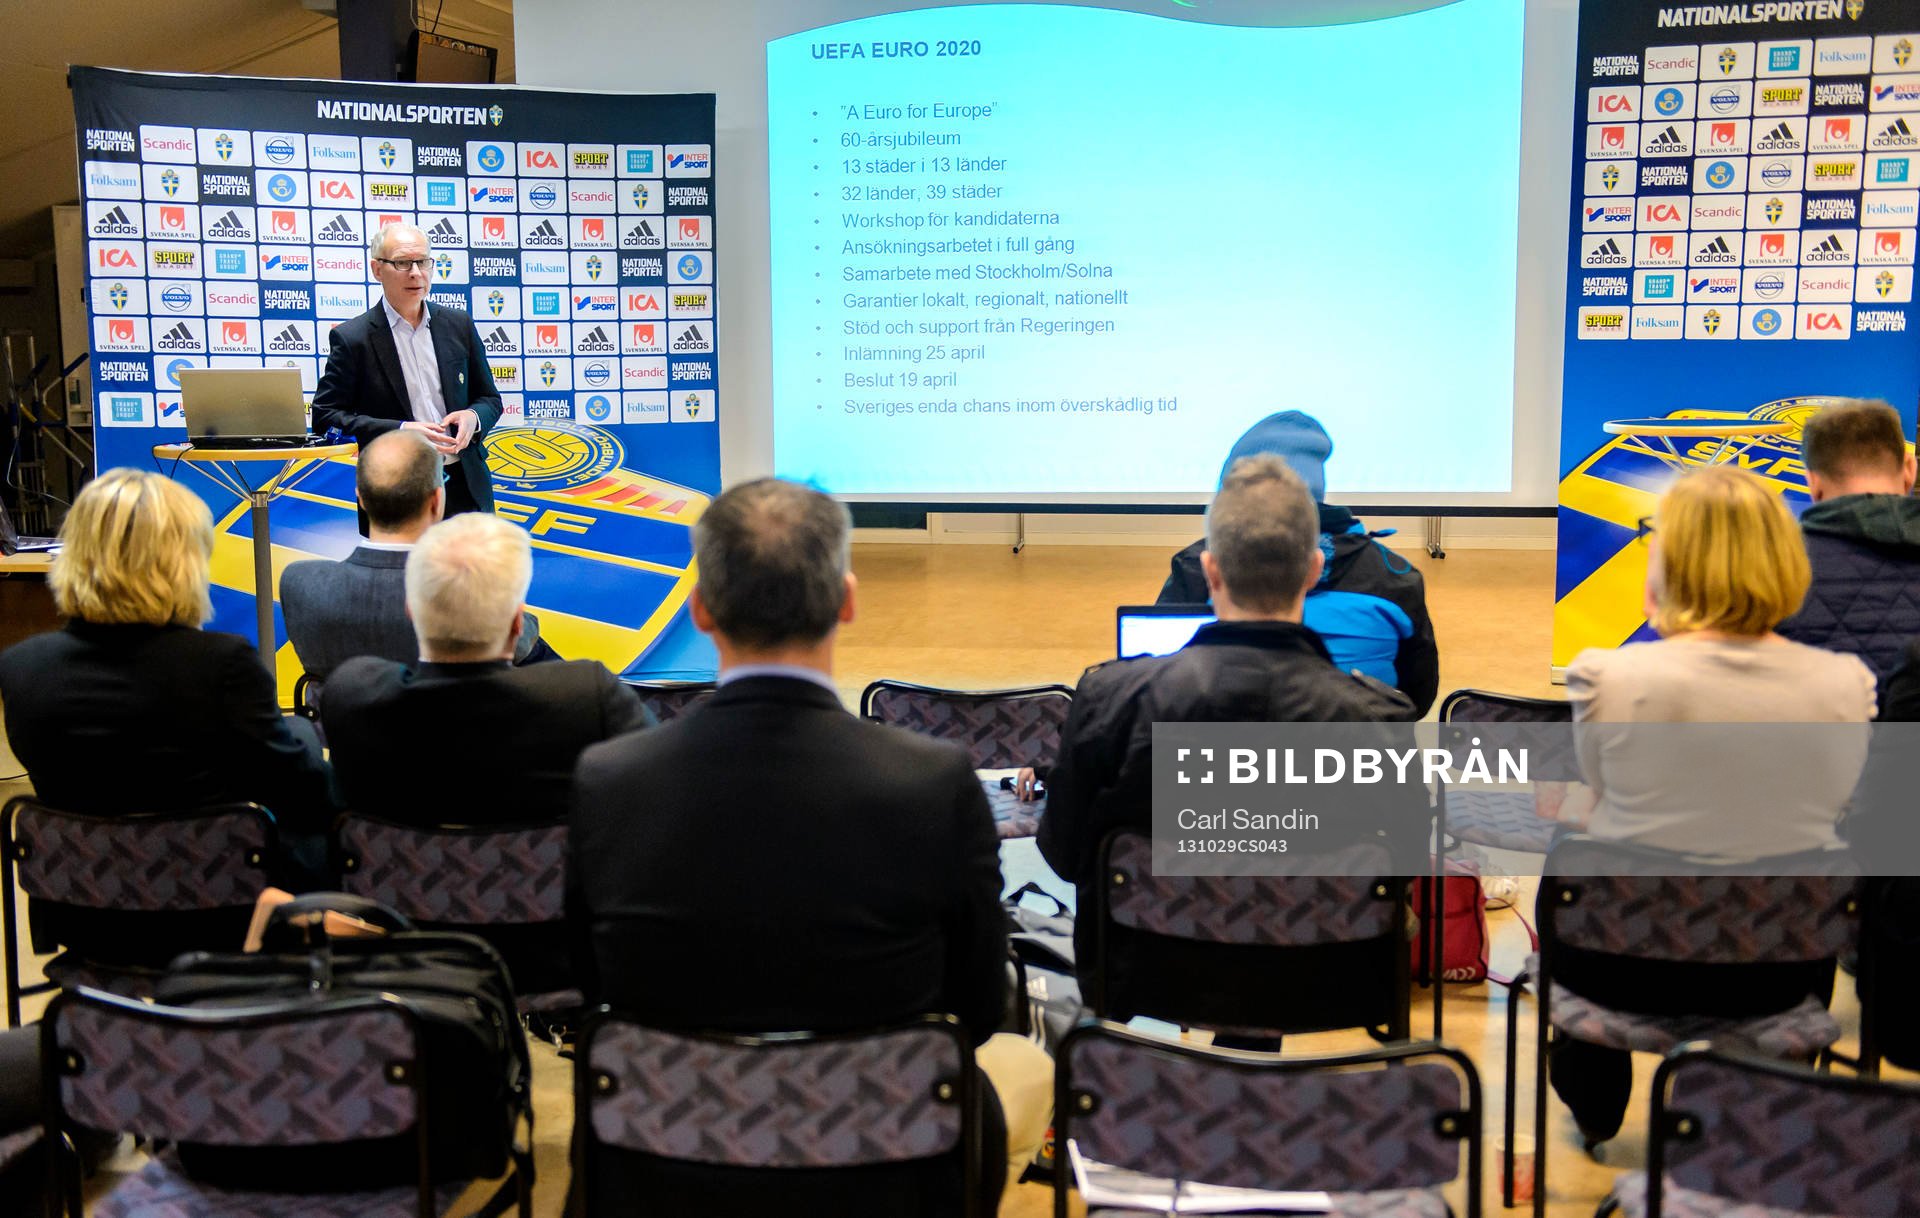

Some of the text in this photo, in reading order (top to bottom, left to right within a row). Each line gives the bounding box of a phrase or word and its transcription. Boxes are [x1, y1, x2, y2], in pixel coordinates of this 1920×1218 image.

[1658, 0, 1842, 27] NATIONALSPORTEN
[812, 40, 981, 59] UEFA EURO 2020
[1593, 56, 1639, 66] NATIONAL
[1648, 58, 1695, 70] Scandic
[1593, 65, 1638, 76] SPORTEN
[1762, 88, 1802, 101] SPORT
[1815, 84, 1864, 96] NATIONAL
[1598, 95, 1632, 112] ICA
[1814, 94, 1863, 105] SPORTEN
[317, 100, 486, 125] NATIONALSPORTEN
[864, 105, 901, 120] Euro
[907, 104, 928, 118] for
[86, 129, 134, 142] NATIONAL
[841, 131, 961, 150] 60-årsjubileum
[87, 140, 134, 152] SPORTEN
[144, 138, 192, 151] Scandic
[1646, 143, 1687, 153] adidas
[1757, 140, 1800, 150] adidas
[313, 147, 356, 159] Folksam
[418, 147, 461, 157] NATIONAL
[418, 157, 461, 167] SPORTEN
[527, 151, 559, 168] ICA
[574, 153, 608, 164] SPORT
[843, 156, 1007, 174] 13 städer i 13 länder
[1642, 167, 1688, 176] NATIONAL
[91, 174, 136, 187] Folksam
[203, 174, 249, 185] NATIONAL
[1641, 176, 1687, 186] SPORTEN
[204, 185, 250, 195] SPORTEN
[320, 181, 355, 199] ICA
[371, 184, 408, 196] SPORT
[669, 187, 707, 196] NATIONAL
[842, 184, 1003, 202] 32 länder, 39 städer
[489, 195, 514, 203] SPORT
[572, 192, 612, 201] Scandic
[669, 196, 707, 205] SPORTEN
[1807, 199, 1855, 209] NATIONAL
[1867, 204, 1913, 214] Folksam
[1647, 205, 1681, 222] ICA
[1695, 207, 1742, 217] Scandic
[1806, 209, 1854, 220] SPORTEN
[842, 210, 1060, 230] Workshop för kandidaterna
[94, 224, 137, 234] adidas
[208, 227, 250, 238] adidas
[318, 232, 358, 241] adidas
[526, 237, 563, 246] adidas
[624, 237, 660, 246] adidas
[842, 236, 1075, 257] Ansökningsarbetet i full gång
[100, 249, 137, 267] ICA
[155, 252, 194, 264] SPORT
[1587, 255, 1627, 264] adidas
[1695, 253, 1736, 263] adidas
[1806, 251, 1849, 261] adidas
[317, 260, 362, 269] Scandic
[474, 258, 516, 267] NATIONAL
[526, 262, 564, 273] Folksam
[622, 258, 662, 267] NATIONAL
[474, 267, 516, 276] SPORTEN
[622, 267, 662, 277] SPORTEN
[843, 263, 1113, 282] Samarbete med Stockholm/Solna
[1583, 277, 1628, 287] NATIONAL
[1802, 280, 1850, 289] Scandic
[265, 290, 309, 300] NATIONAL
[1583, 287, 1628, 296] SPORTEN
[209, 293, 256, 304] Scandic
[320, 296, 362, 307] Folksam
[629, 294, 659, 310] ICA
[844, 289, 1128, 310] Garantier lokalt, regionalt, nationellt
[265, 300, 309, 309] SPORTEN
[1586, 315, 1622, 326] SPORT
[1857, 311, 1905, 321] NATIONAL
[1636, 318, 1678, 327] Folksam
[1806, 313, 1842, 330] ICA
[1856, 320, 1905, 331] SPORTEN
[844, 317, 1115, 338] Stöd och support från Regeringen
[158, 339, 200, 349] adidas
[270, 341, 310, 351] adidas
[578, 342, 614, 351] adidas
[673, 340, 708, 350] adidas
[844, 345, 985, 364] Inlämning 25 april
[100, 362, 148, 372] NATIONAL
[672, 362, 711, 372] NATIONAL
[101, 371, 148, 381] SPORTEN
[625, 368, 664, 377] Scandic
[672, 371, 711, 380] SPORTEN
[845, 372, 957, 389] Beslut 19 april
[529, 400, 569, 409] NATIONAL
[628, 403, 664, 412] Folksam
[845, 397, 1178, 418] Sveriges enda chans inom överskådlig tid
[529, 409, 569, 418] SPORTEN
